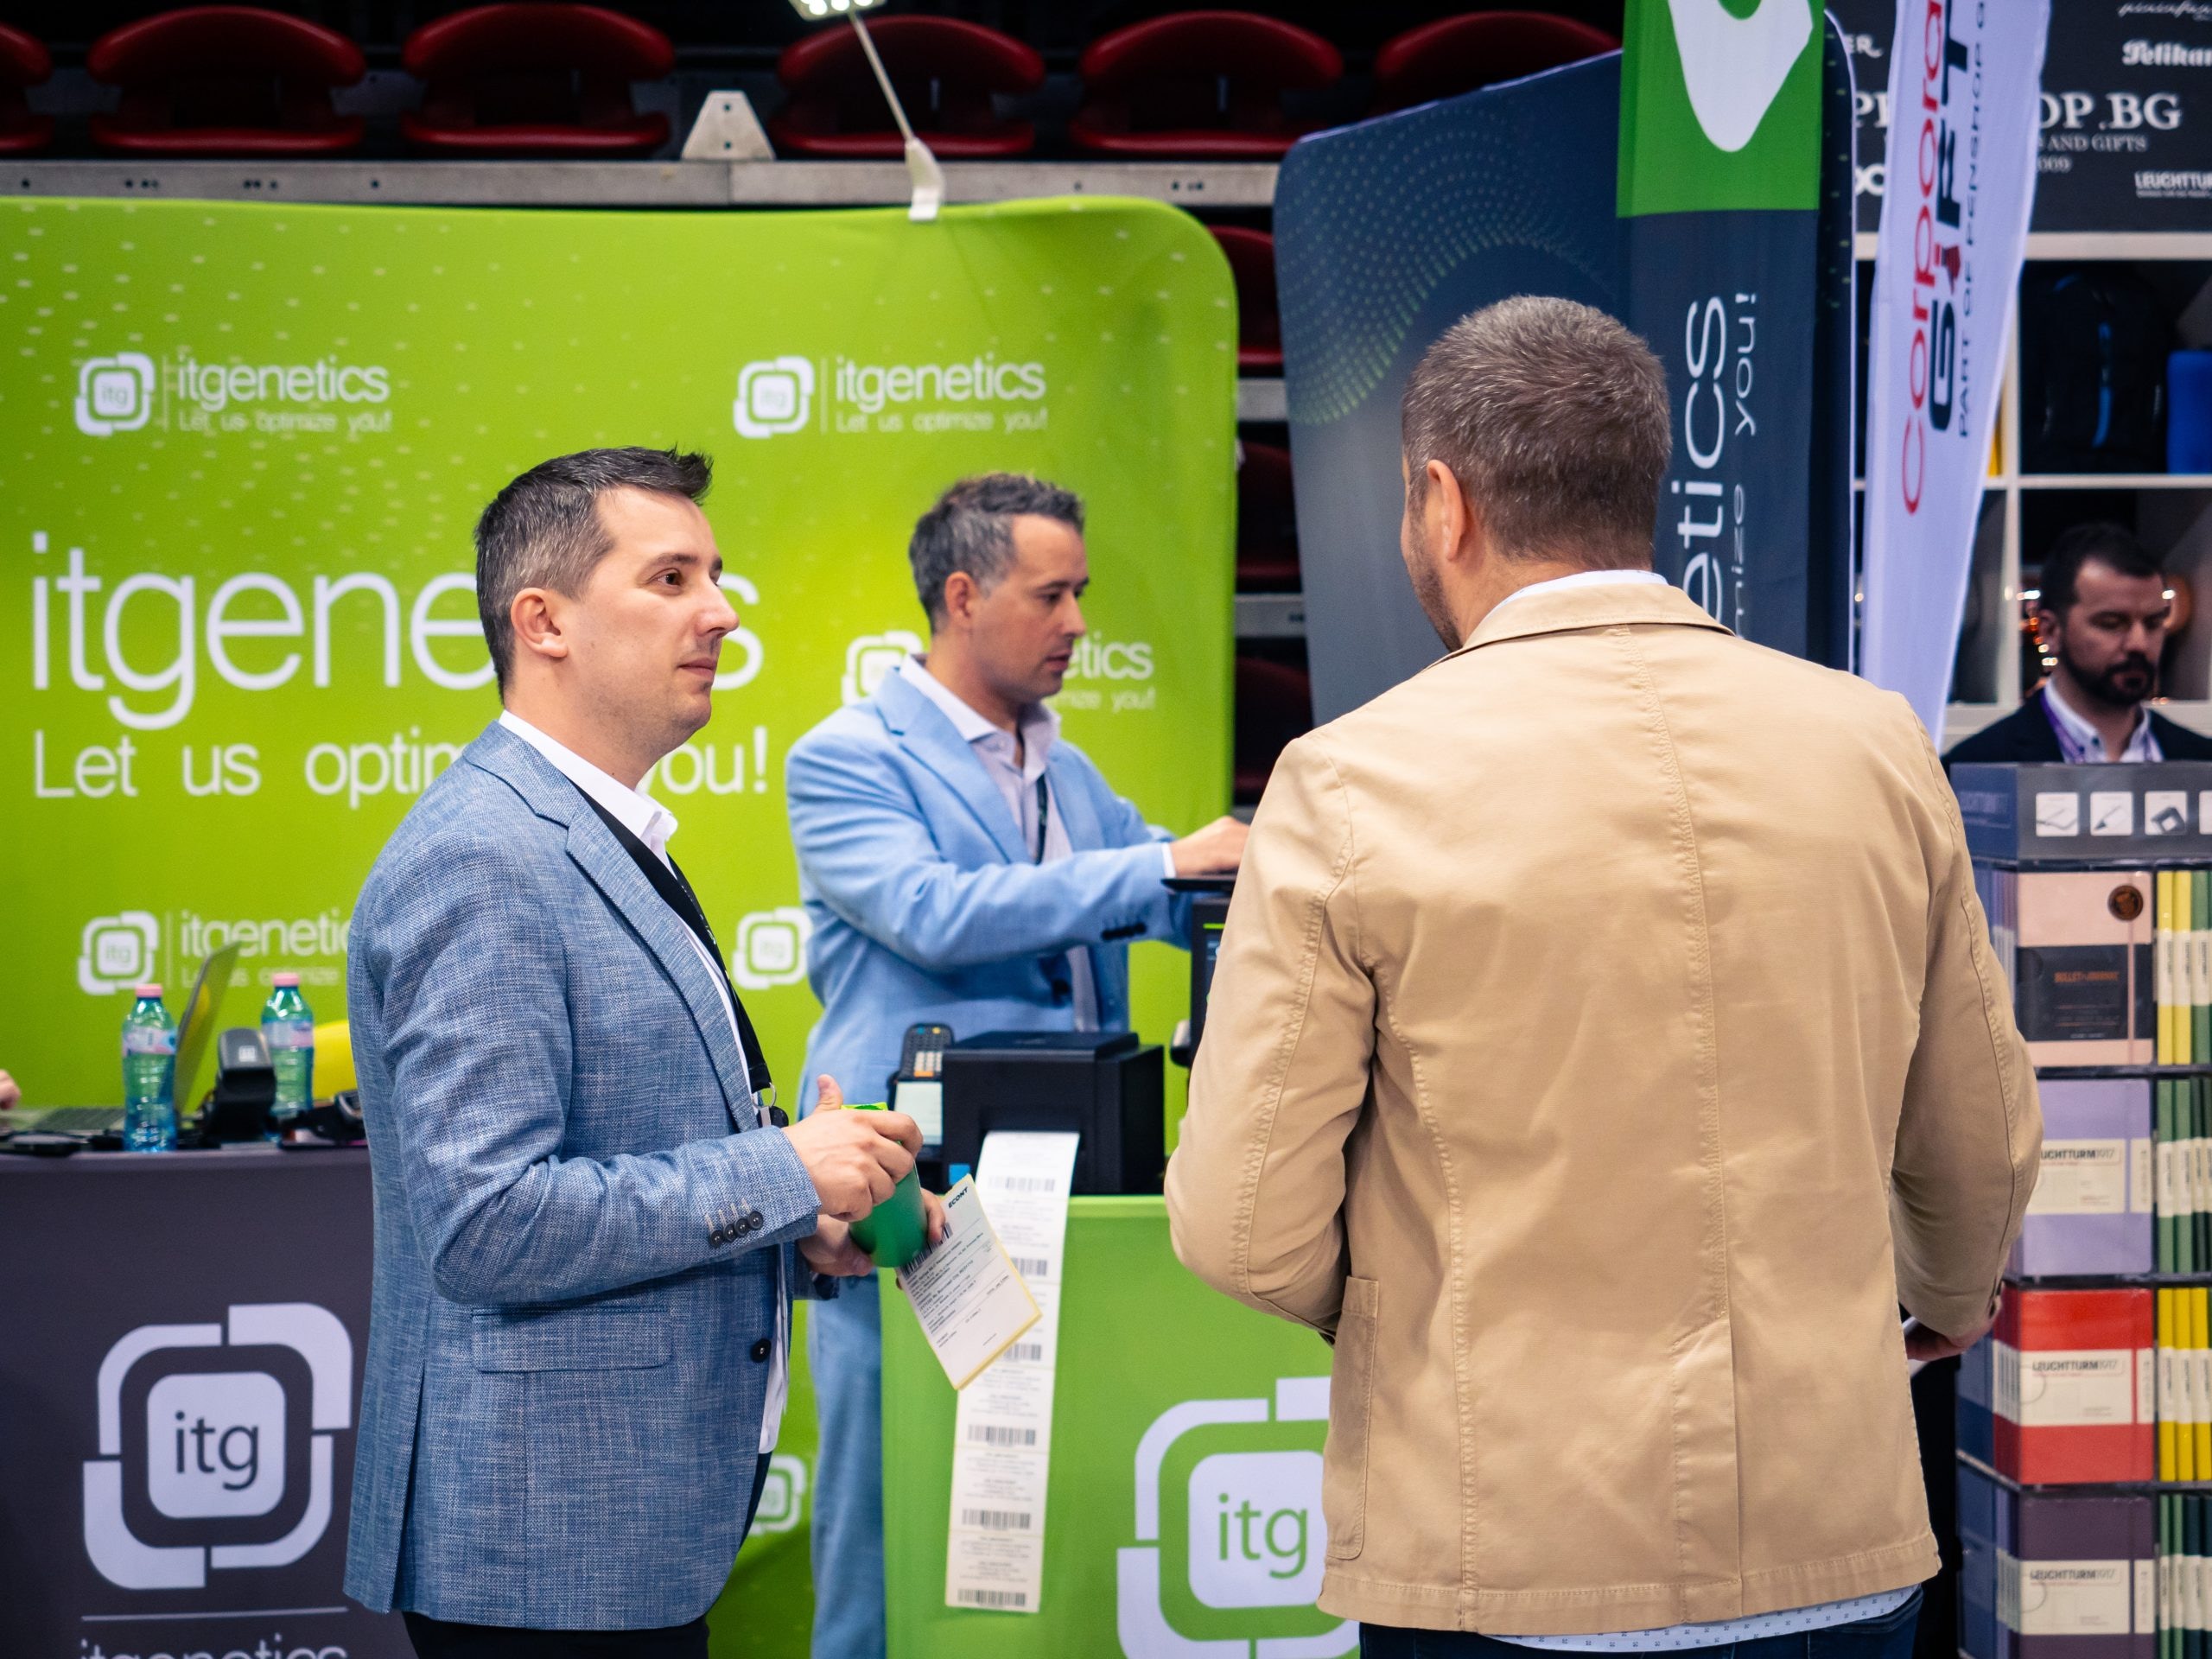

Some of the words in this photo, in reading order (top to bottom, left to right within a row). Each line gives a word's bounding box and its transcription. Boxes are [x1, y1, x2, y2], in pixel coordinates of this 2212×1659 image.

[2047, 135, 2088, 152] AND
[2092, 134, 2148, 153] GIFTS
[1902, 0, 1942, 516] Corpora
[1963, 261, 1974, 318] OF
[178, 353, 391, 412] itgenetics
[836, 353, 1047, 414] itgenetics
[1735, 293, 1758, 436] you!
[1959, 329, 1971, 438] PART
[179, 410, 213, 431] Let
[221, 413, 248, 431] us
[836, 411, 868, 432] Let
[878, 414, 903, 431] us
[1004, 406, 1049, 435] you!
[1671, 296, 1727, 624] etics
[1732, 484, 1745, 639] mize
[33, 531, 766, 731] itgenes
[35, 730, 138, 799] Let
[182, 741, 261, 797] us
[636, 725, 769, 796] ou!
[181, 907, 348, 958] itgeneti
[948, 1185, 969, 1210] ECONT
[175, 1409, 261, 1491] itg
[1217, 1492, 1309, 1580] itg
